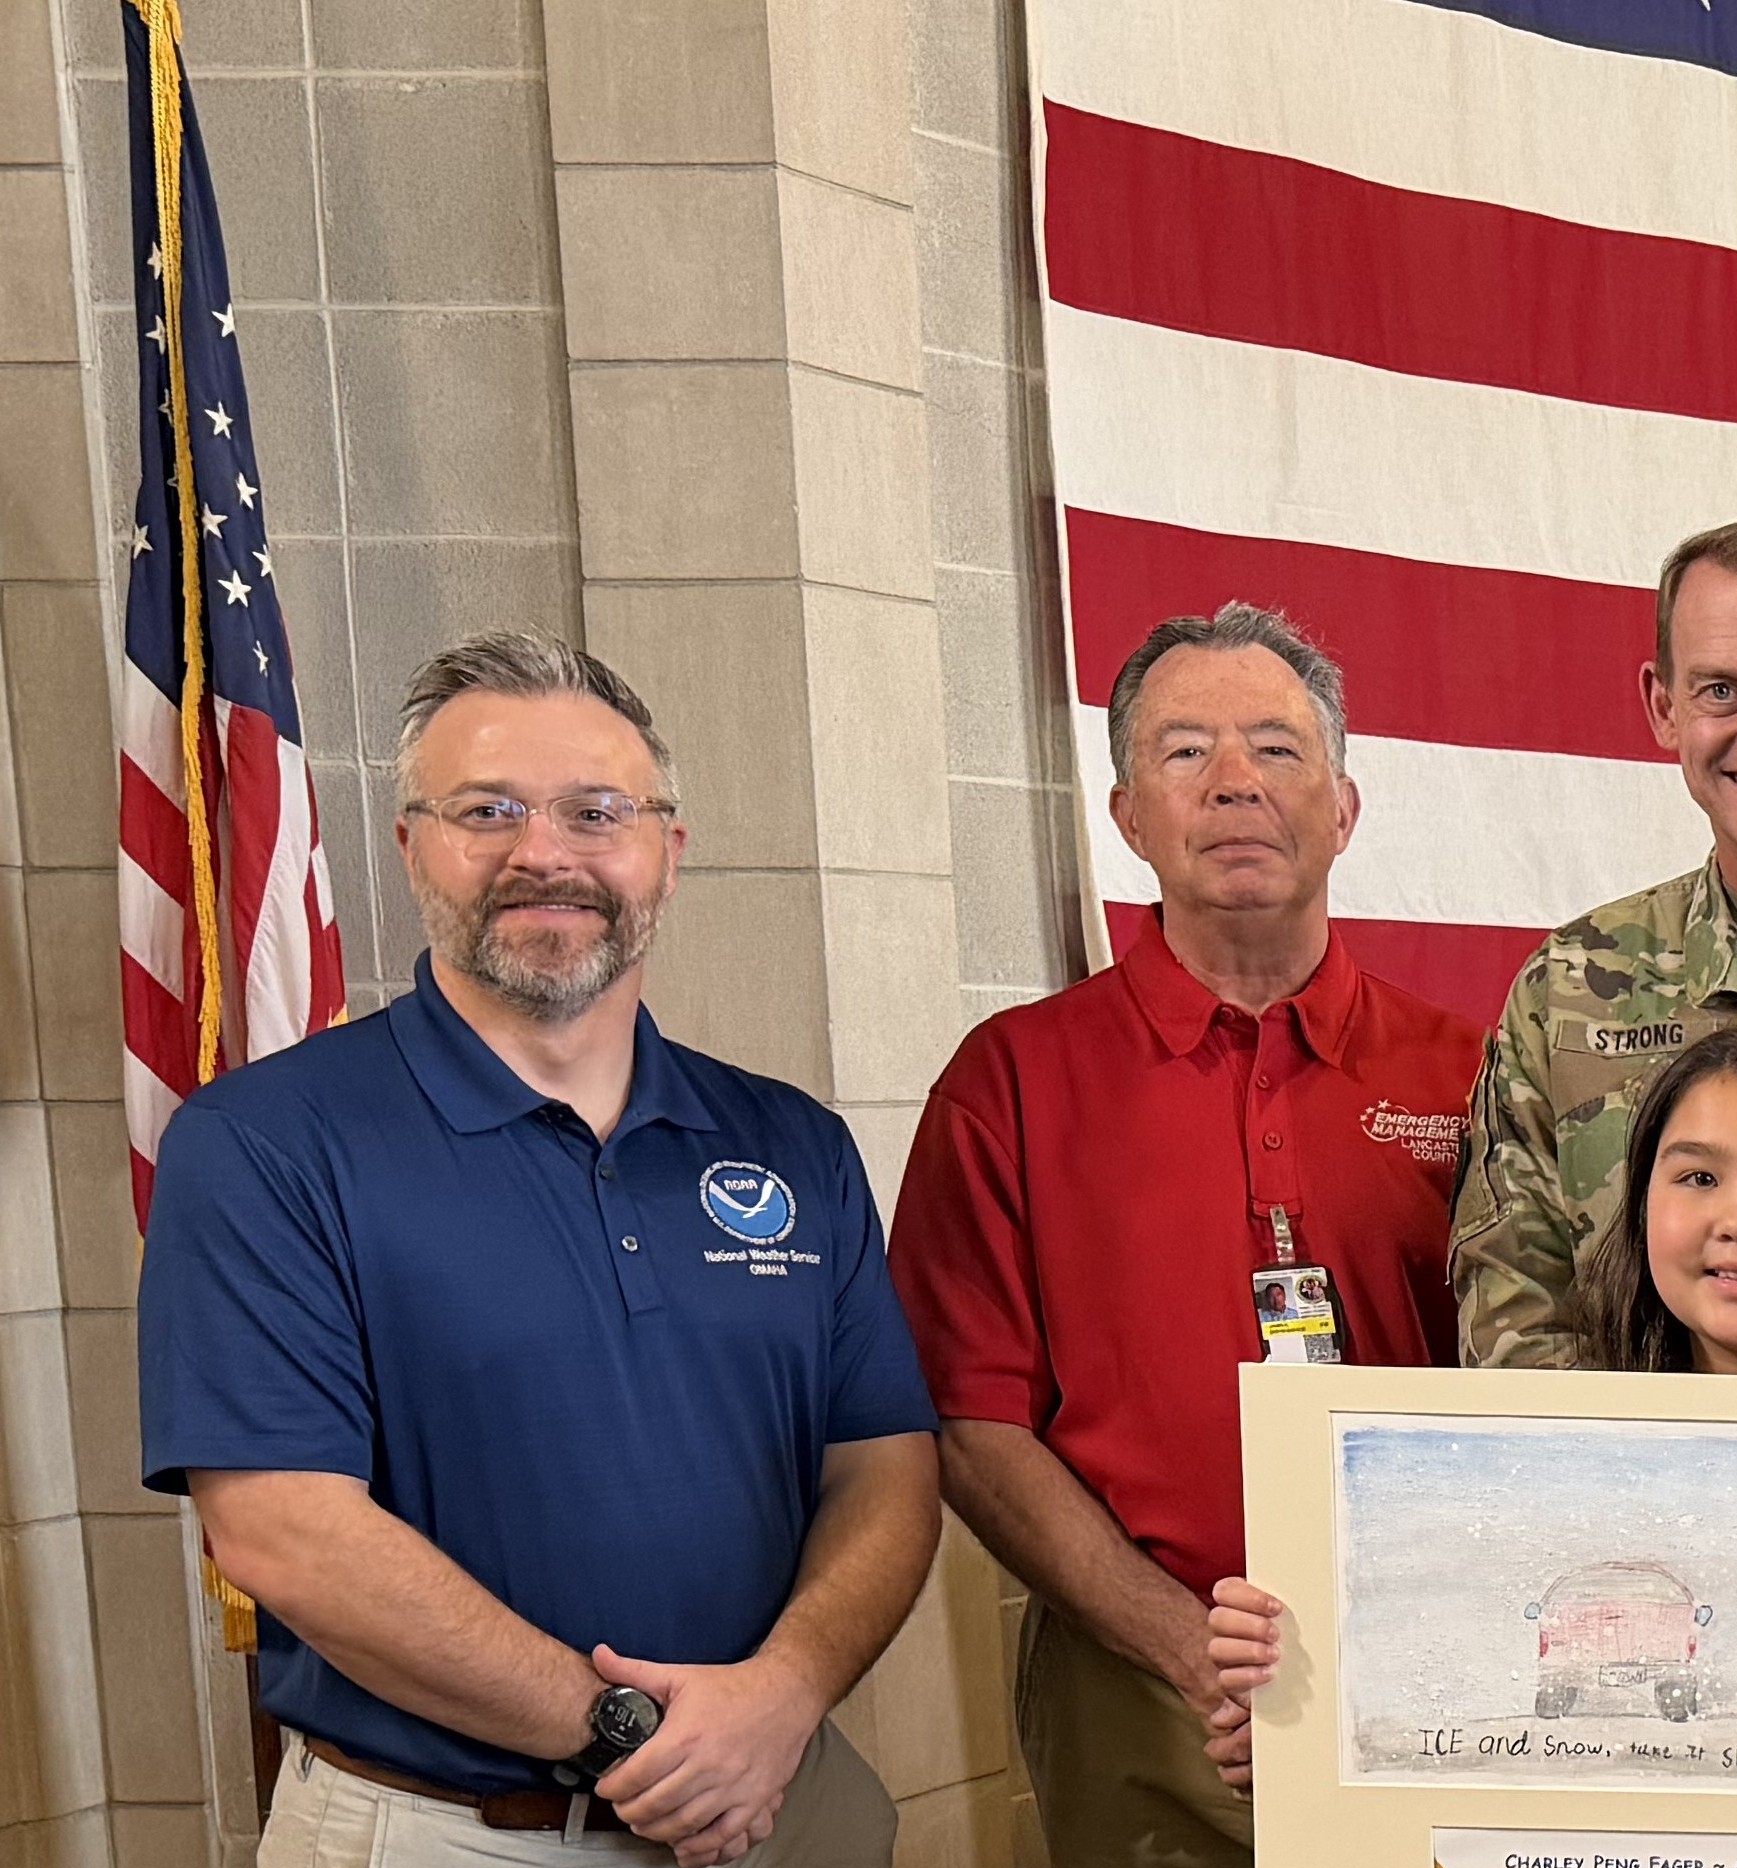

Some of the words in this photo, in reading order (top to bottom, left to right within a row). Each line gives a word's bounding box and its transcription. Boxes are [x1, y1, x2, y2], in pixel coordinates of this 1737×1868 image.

[1595, 1022, 1684, 1051] STRONG
[1374, 1112, 1468, 1129] EMERGENCY
[1370, 1122, 1459, 1140] MANAGEME
[703, 1250, 748, 1263] National
[748, 1248, 789, 1262] Weather
[790, 1250, 821, 1264] Service
[1418, 1728, 1463, 1757] ICE
[1478, 1730, 1532, 1757] and
